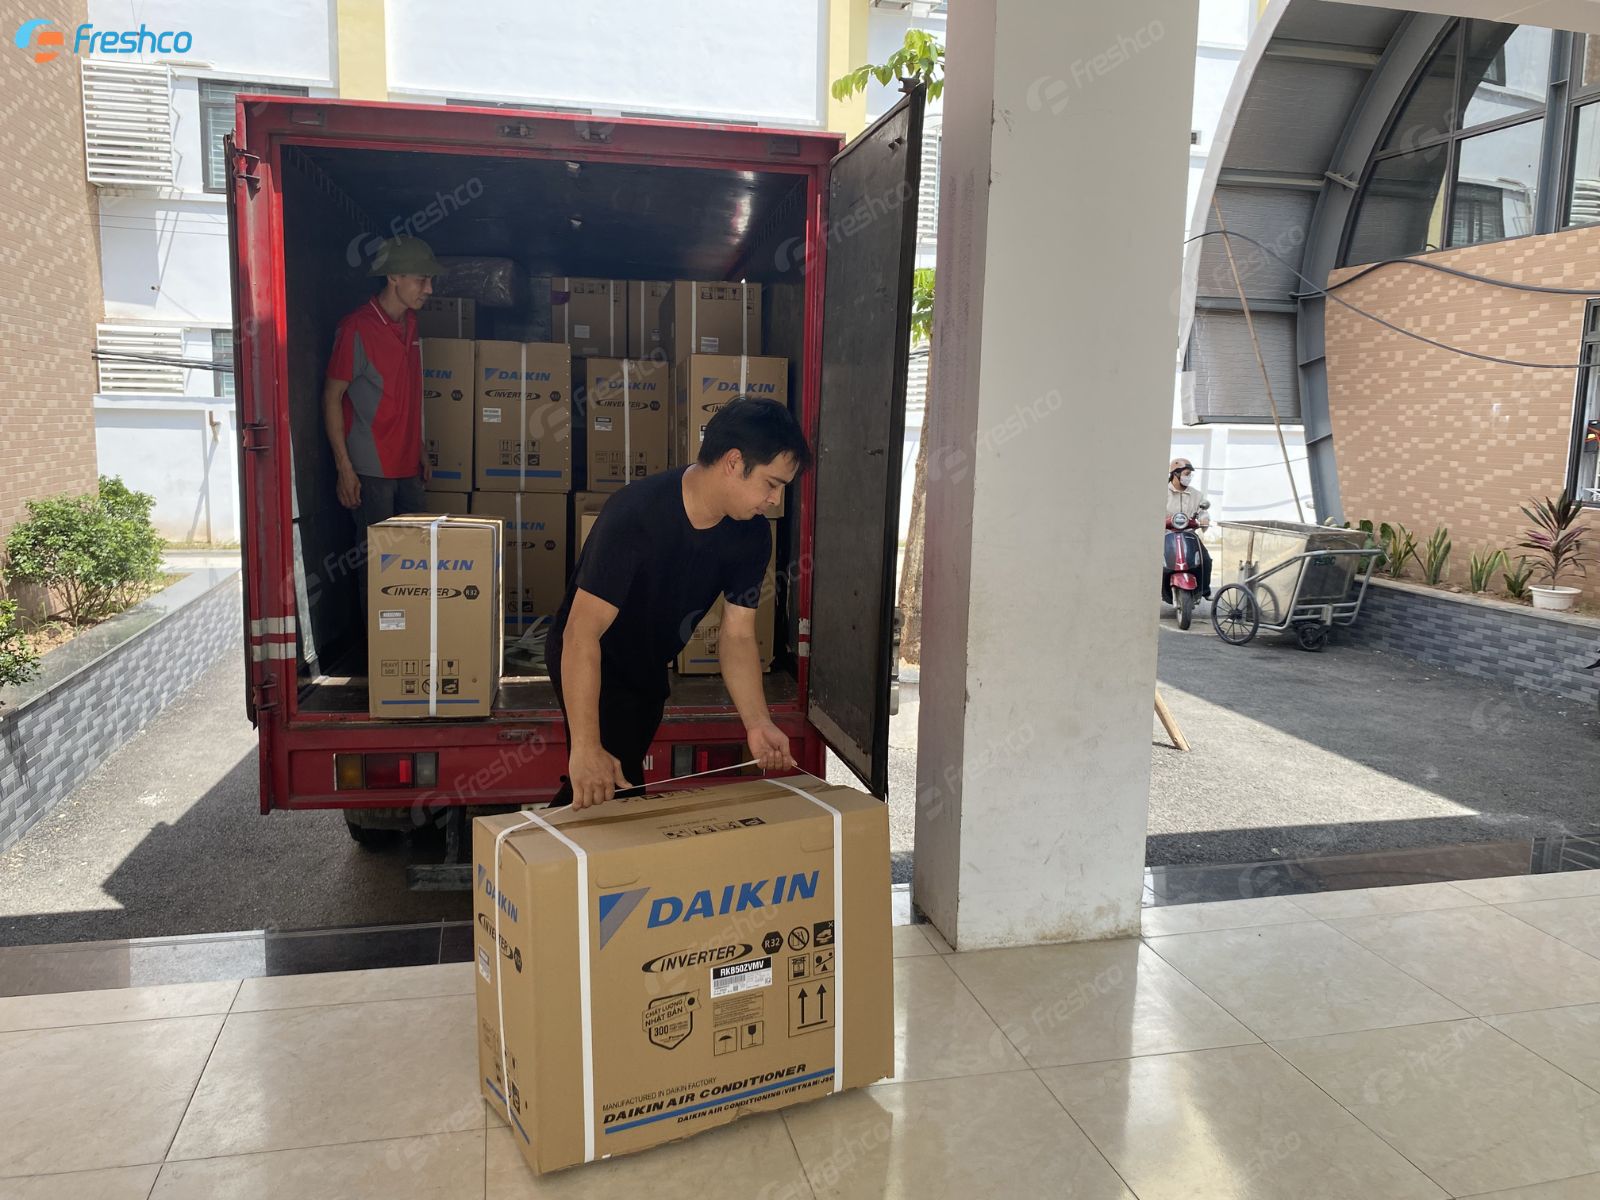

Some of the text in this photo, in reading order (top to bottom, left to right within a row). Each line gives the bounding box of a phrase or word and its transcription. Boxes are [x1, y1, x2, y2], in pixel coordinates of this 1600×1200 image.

[423, 369, 453, 379] KIN
[498, 370, 551, 382] DAKIN
[608, 381, 657, 391] DAKIN
[716, 381, 776, 393] DAKIN
[494, 391, 532, 399] INVERTR
[400, 559, 475, 571] DAKIN
[394, 587, 450, 597] INVERER
[647, 870, 820, 929] DAIKIN
[483, 918, 509, 954] INVETER
[764, 936, 781, 949] R32
[660, 944, 737, 972] INVERTER
[720, 960, 764, 977] RKB50ZVMV
[654, 1025, 669, 1037] 300
[602, 1076, 717, 1112] MANUFACTURED IN DAIKIN FACTORY
[603, 1063, 807, 1124] DAIKIN AIR CONDITIONER
[677, 1112, 707, 1124] DAIKIN
[707, 1106, 723, 1115] AIR
[724, 1090, 781, 1112] CONDITIONING
